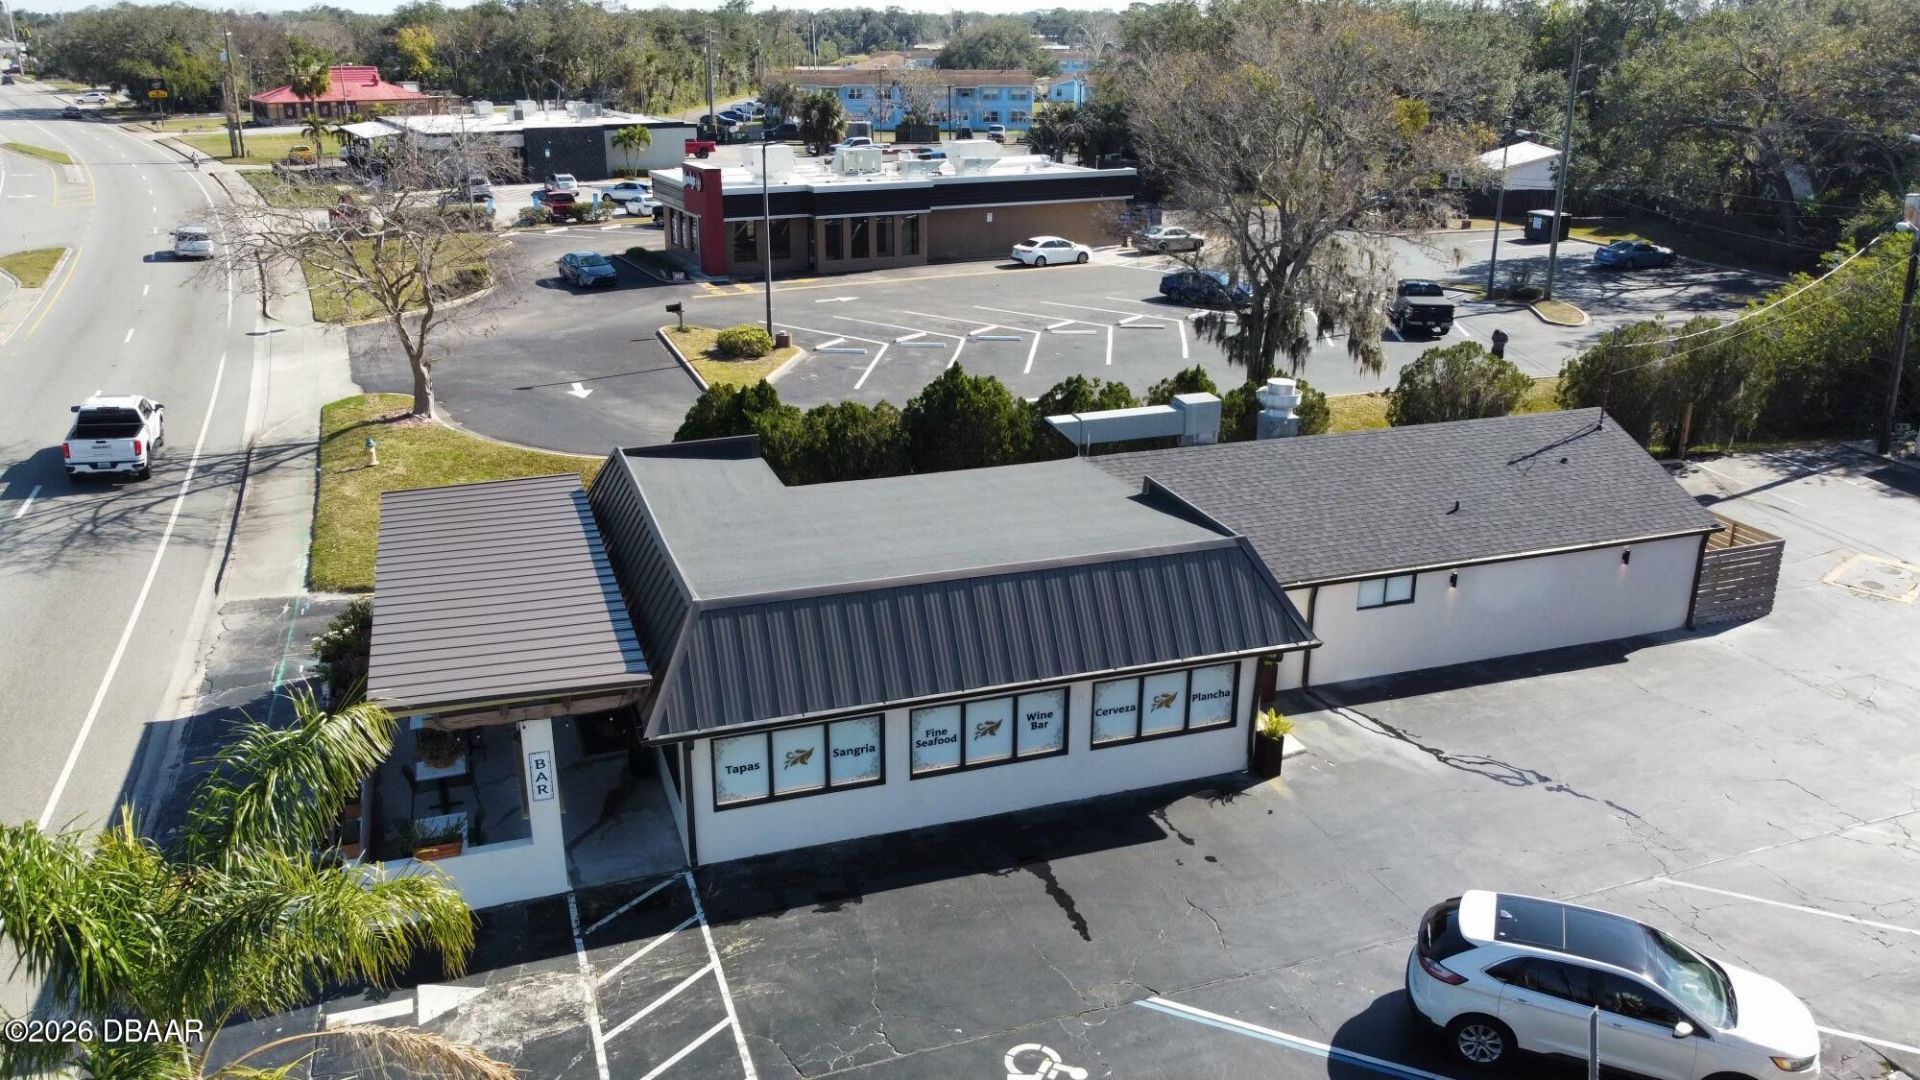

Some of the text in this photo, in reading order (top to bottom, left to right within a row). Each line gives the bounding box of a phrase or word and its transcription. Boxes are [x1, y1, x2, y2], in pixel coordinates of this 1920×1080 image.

[1192, 689, 1231, 702] Plancha
[1026, 711, 1054, 722] Wine
[1095, 704, 1136, 717] Cerveza
[1031, 720, 1049, 731] Bar
[925, 727, 948, 738] Fine
[915, 734, 957, 749] Seafood
[833, 743, 876, 758] Sangria
[725, 761, 760, 776] Tapas
[534, 758, 549, 795] BAR
